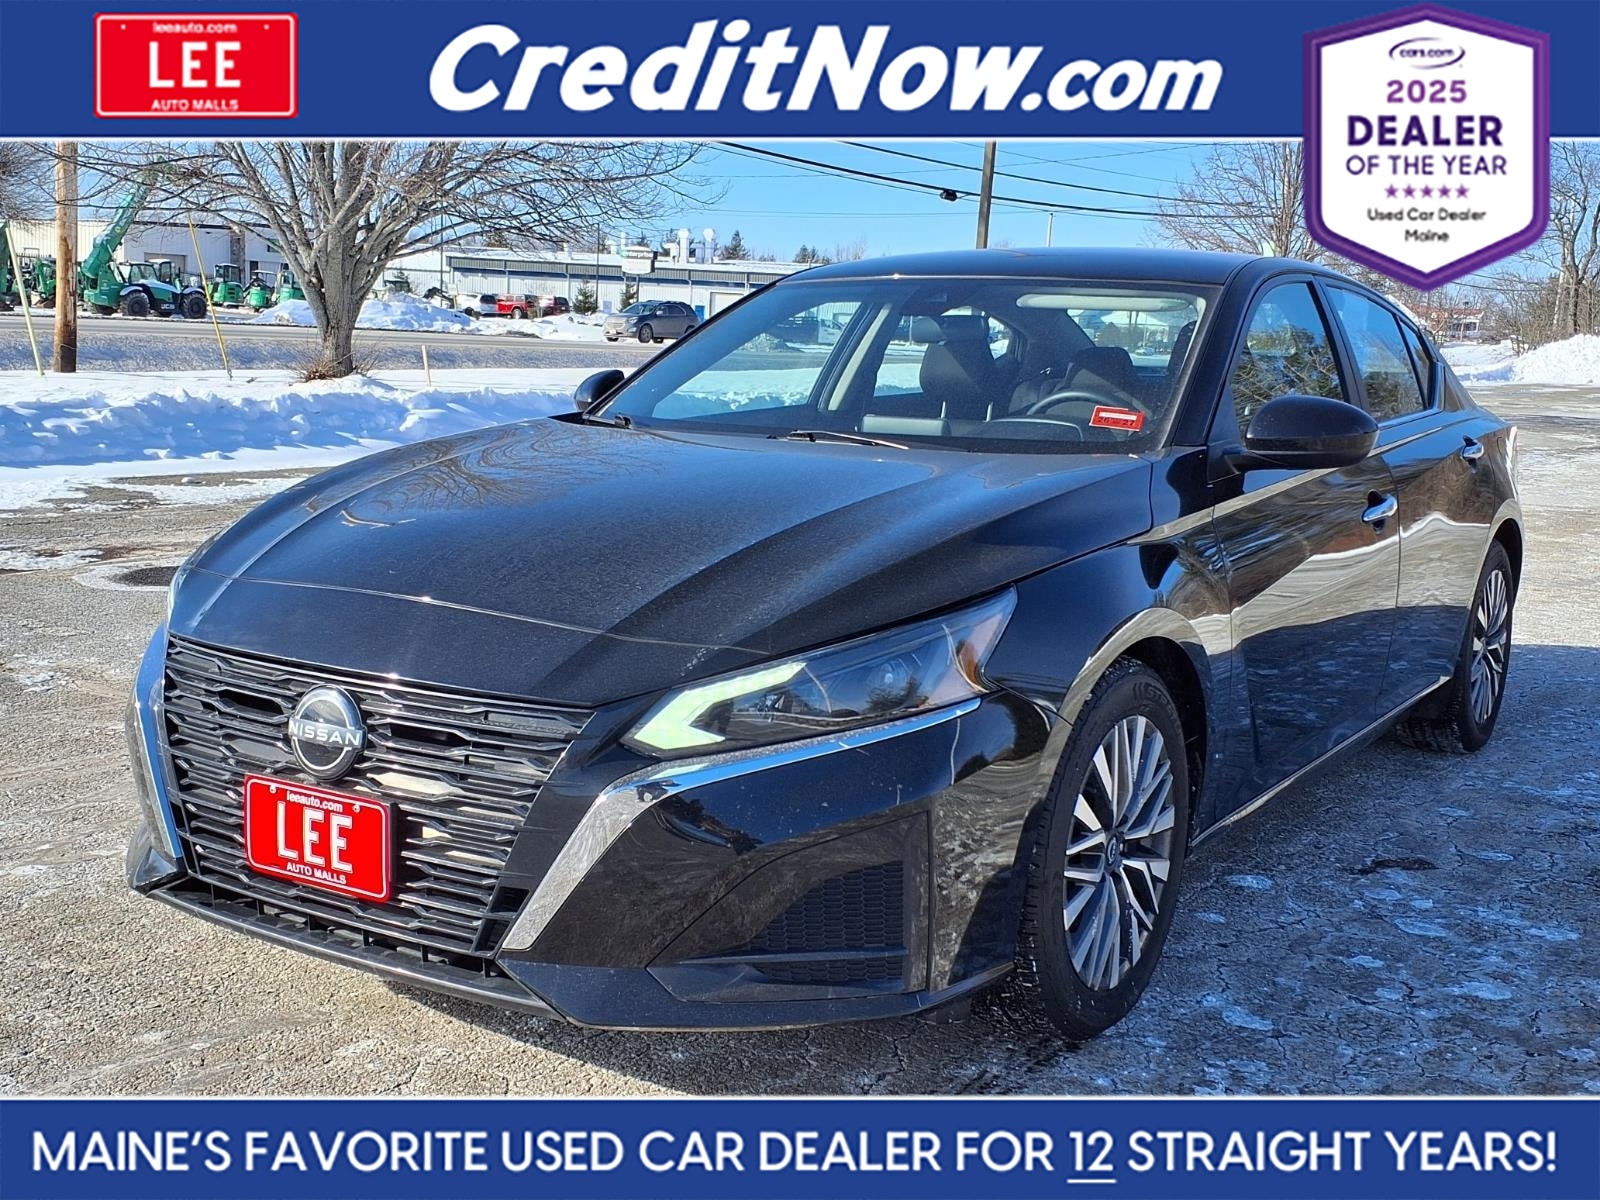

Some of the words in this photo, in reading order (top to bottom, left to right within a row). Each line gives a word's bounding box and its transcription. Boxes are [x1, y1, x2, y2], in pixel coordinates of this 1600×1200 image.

[289, 719, 360, 746] NISSAN
[286, 790, 343, 812] leeauto.com
[276, 800, 353, 874] LEE
[286, 861, 312, 876] AUTO
[313, 868, 347, 885] MALLS
